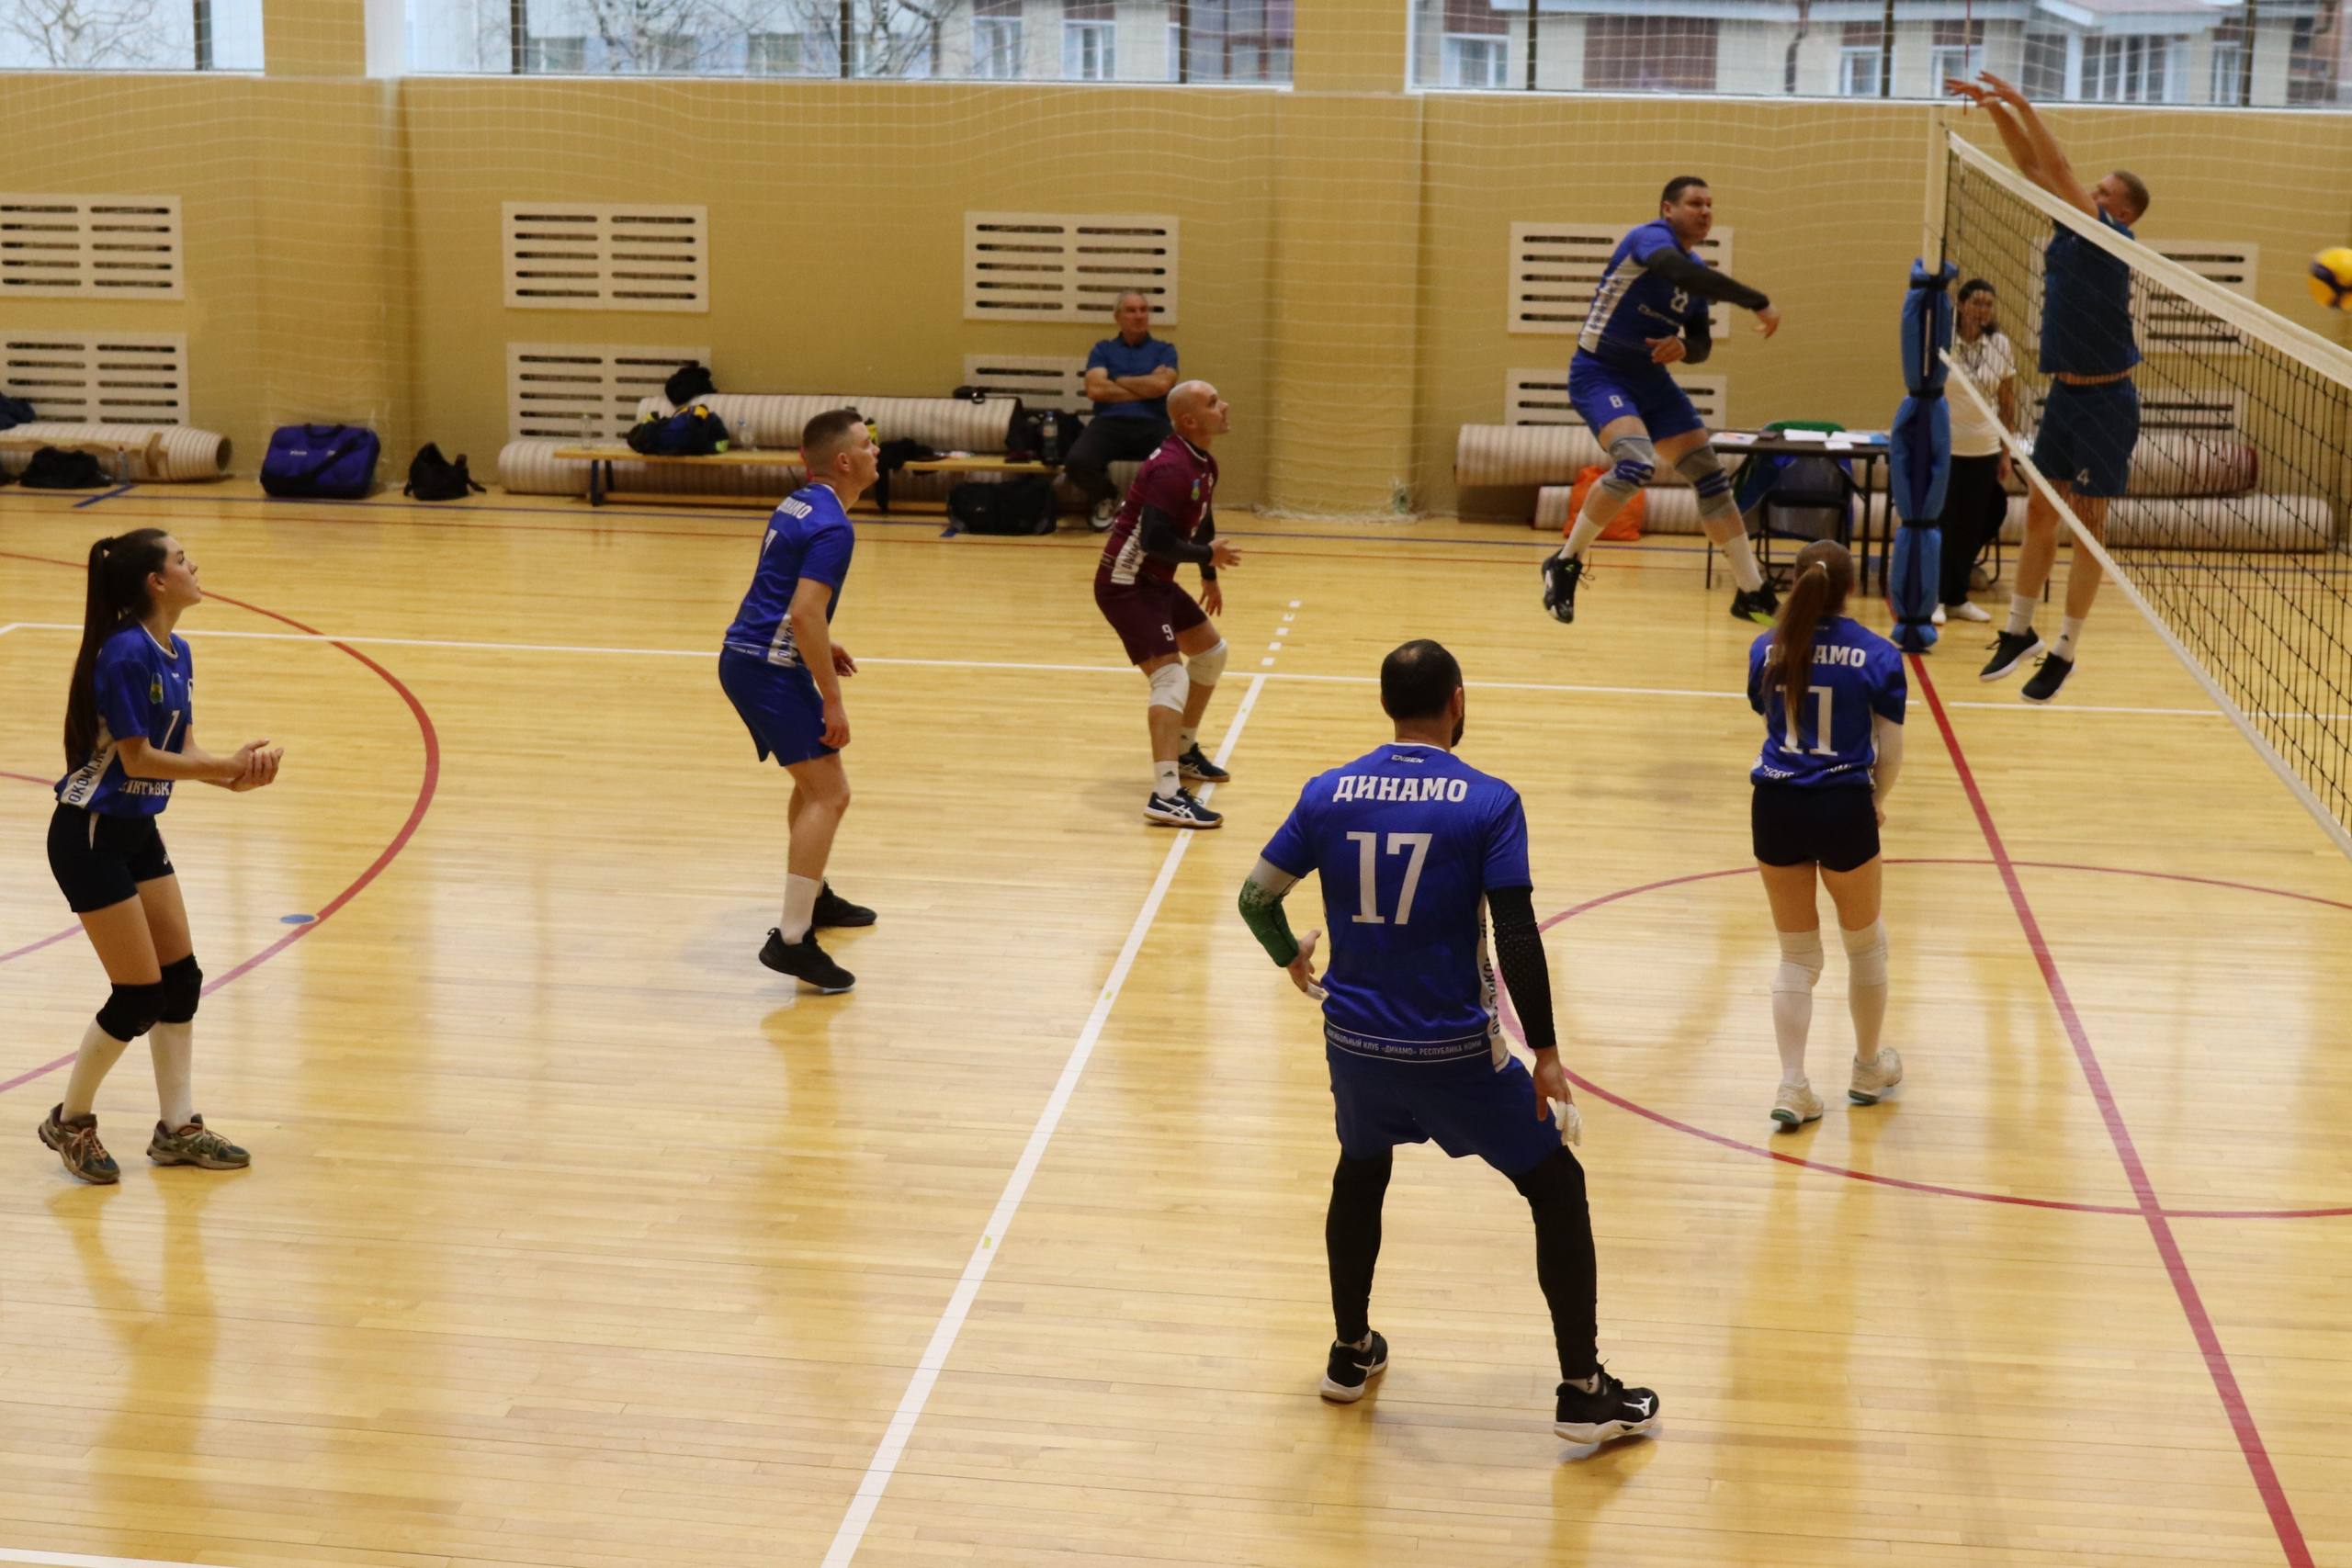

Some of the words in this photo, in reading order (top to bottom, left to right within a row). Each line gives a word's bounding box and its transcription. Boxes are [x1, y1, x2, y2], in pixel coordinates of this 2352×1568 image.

[2076, 468, 2090, 486] 4
[1161, 624, 1175, 641] 9
[1775, 683, 1838, 756] 11
[1332, 775, 1468, 803] ДИНАМО
[1346, 830, 1433, 925] 17
